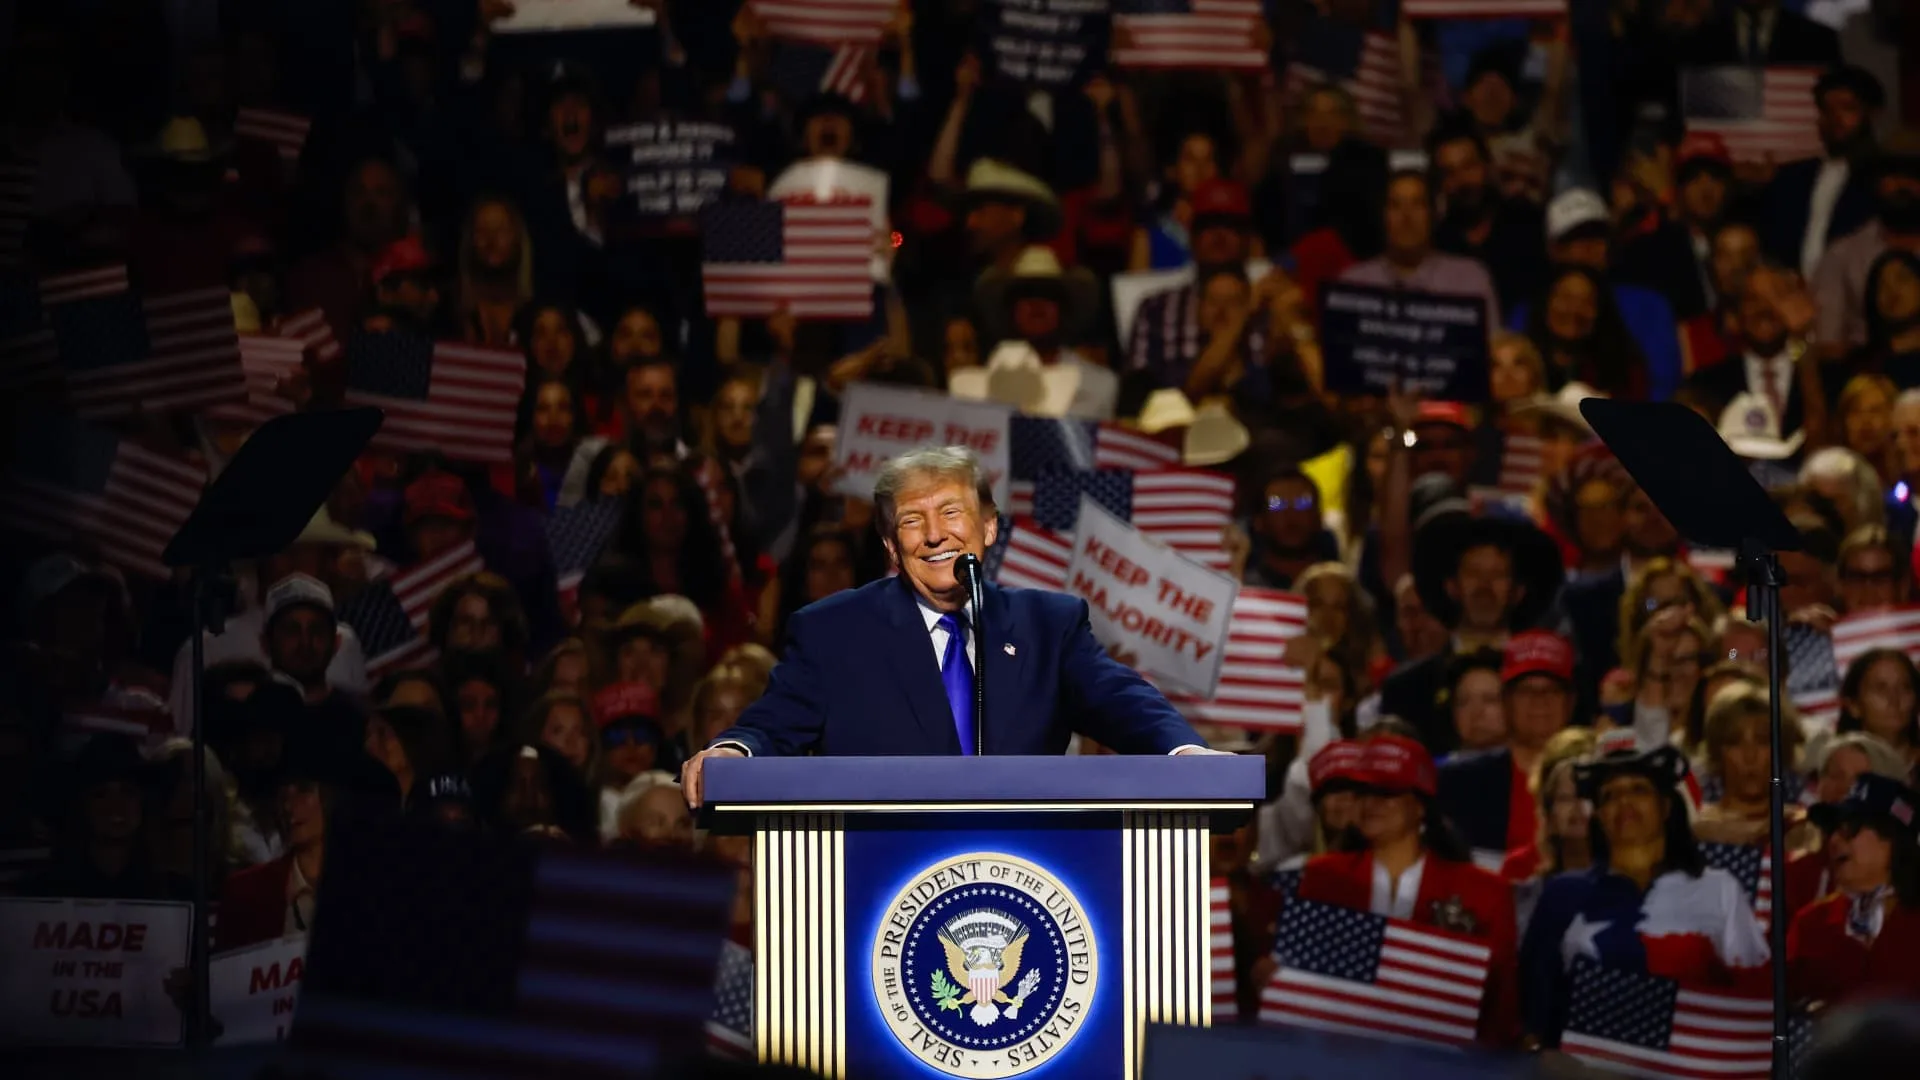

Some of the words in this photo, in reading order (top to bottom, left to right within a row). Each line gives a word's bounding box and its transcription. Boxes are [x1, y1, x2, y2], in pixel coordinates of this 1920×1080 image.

[857, 413, 935, 443] KEEP
[943, 422, 998, 454] THE
[1083, 536, 1150, 586] KEEP
[1157, 578, 1215, 624] THE
[1072, 570, 1214, 663] MAJORITY
[989, 865, 1011, 879] OF
[1014, 870, 1045, 894] THE
[881, 861, 982, 960] PRESIDENT
[34, 920, 148, 952] MADE
[1046, 889, 1089, 985] UNITED
[53, 959, 76, 978] IN
[82, 961, 125, 979] THE
[883, 966, 898, 1000] THE
[50, 988, 124, 1020] USA
[272, 996, 293, 1016] IN
[891, 1002, 909, 1023] OF
[907, 1021, 965, 1069] SEAL
[1006, 997, 1081, 1069] STATES
